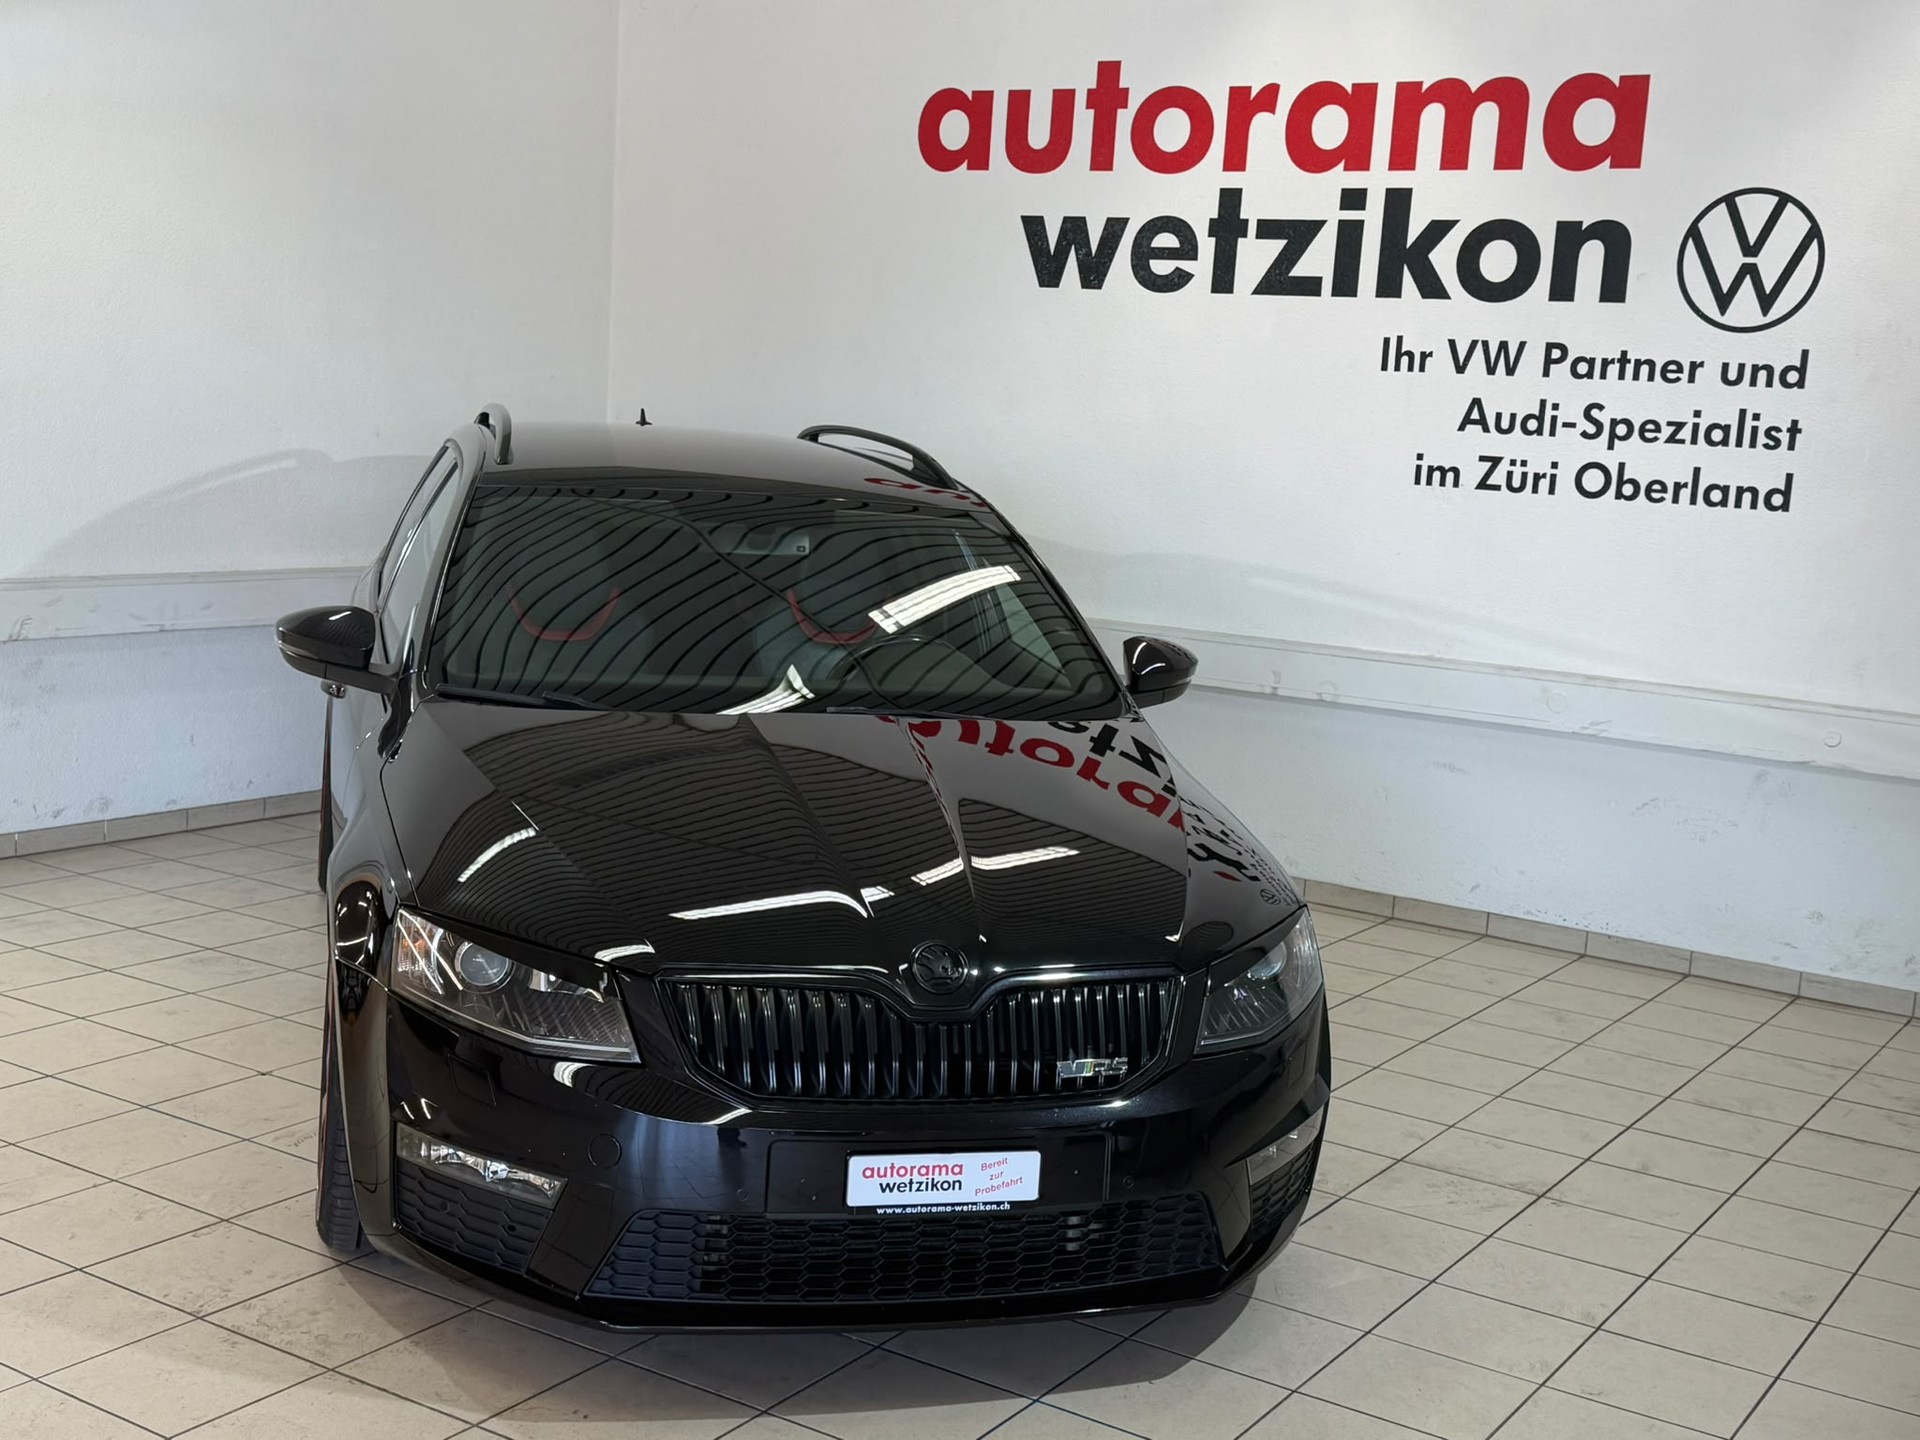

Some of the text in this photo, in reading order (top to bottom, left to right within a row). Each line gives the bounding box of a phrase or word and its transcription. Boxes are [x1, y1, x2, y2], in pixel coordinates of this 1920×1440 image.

[917, 60, 1651, 175] autorama
[1020, 187, 1632, 304] wetzikon
[1380, 335, 1810, 390] Ihr VW Partner und
[1457, 397, 1803, 452] Audi-Spezialist
[1414, 452, 1794, 513] im Züri Oberland
[861, 1162, 964, 1179] autorama
[980, 1157, 1009, 1171] Bereit
[879, 1177, 963, 1194] wetzikon
[974, 1176, 1023, 1197] Probefahrt
[989, 1171, 1004, 1181] zur
[876, 1201, 1011, 1215] www.autorama-wetzikon.ch
